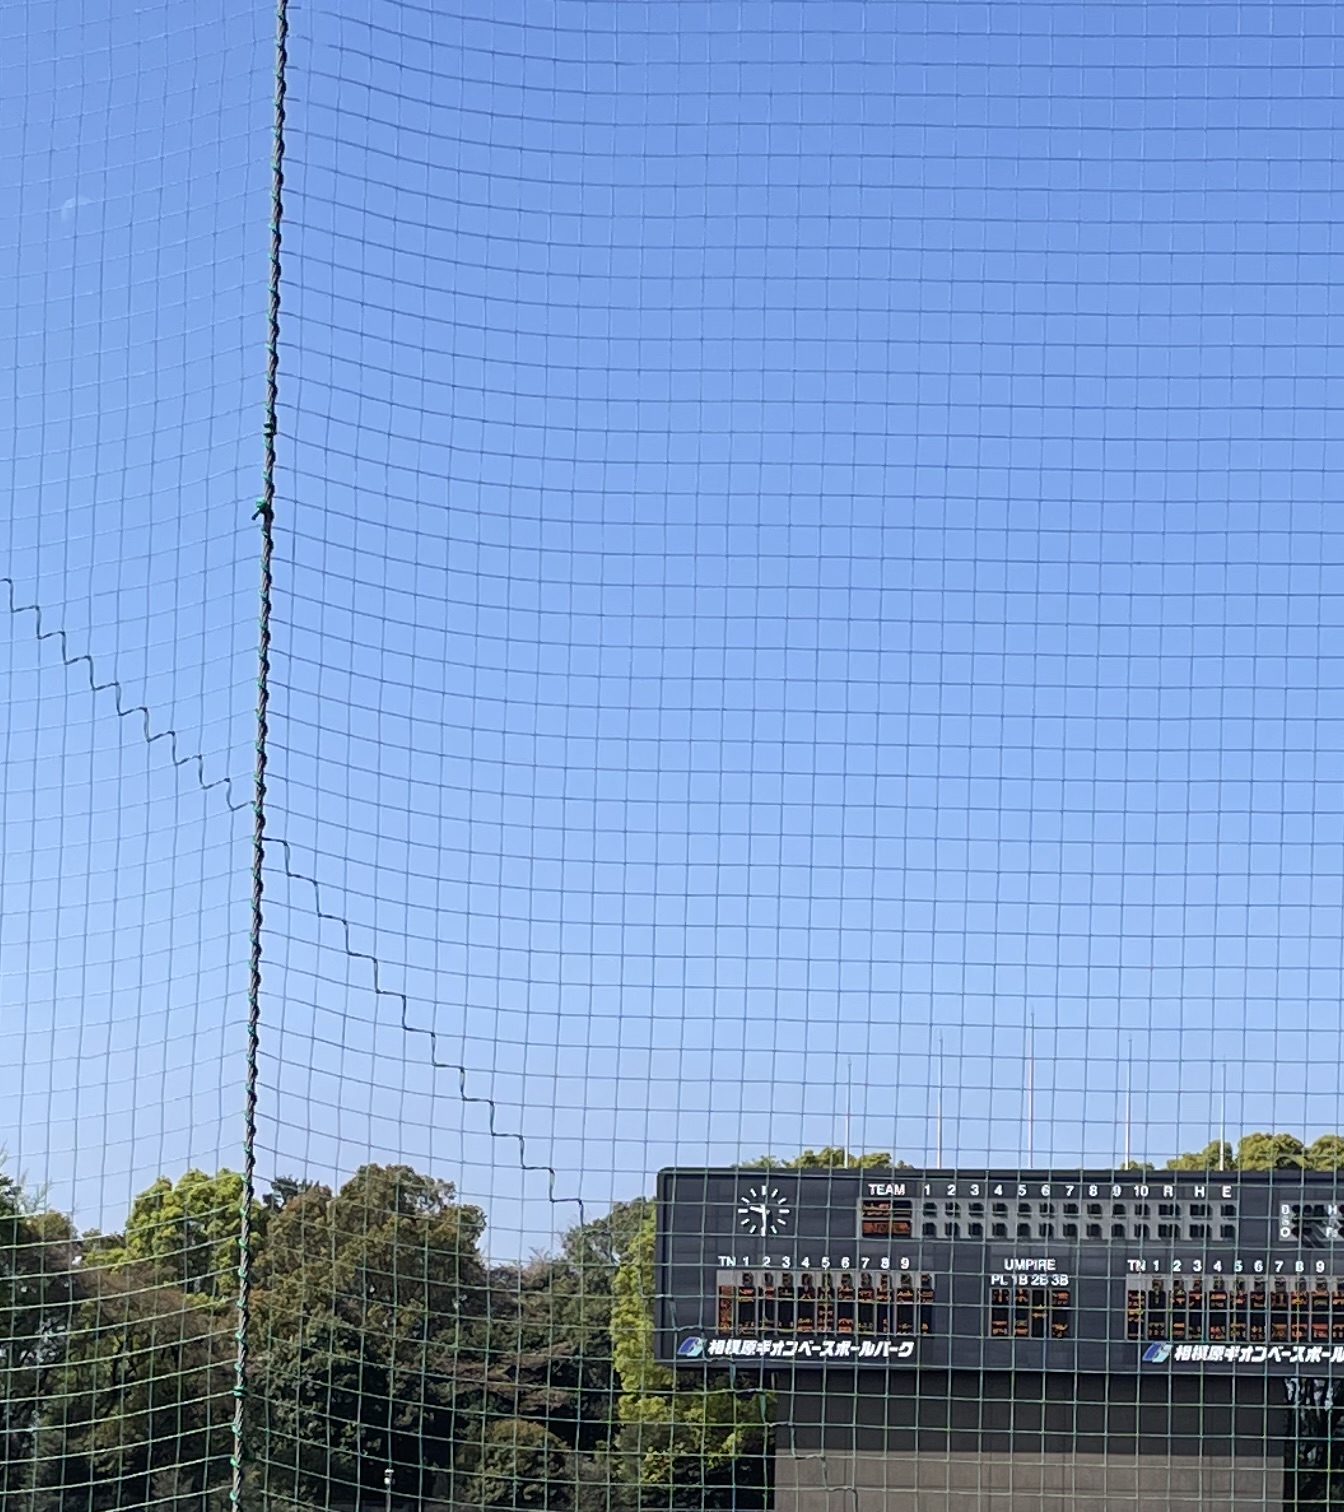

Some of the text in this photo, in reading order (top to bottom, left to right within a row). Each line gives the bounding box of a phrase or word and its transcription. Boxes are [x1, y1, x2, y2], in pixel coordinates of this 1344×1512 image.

[868, 1184, 1231, 1198] TEAM 1 2 3 4 5 6 7 8 9 10 R H E
[1328, 1204, 1338, 1215] H
[718, 1256, 909, 1269] TN 1 2 3 4 5 6 7 8 9
[1004, 1258, 1056, 1271] UMPIRE
[1127, 1260, 1325, 1272] TN 1 2 3 4 5 6 7 8 9
[991, 1275, 1008, 1286] PL
[1031, 1275, 1048, 1286] 2B
[1051, 1275, 1069, 1286] 3B
[708, 1339, 915, 1358] 相模原ギオンベースボールパーク
